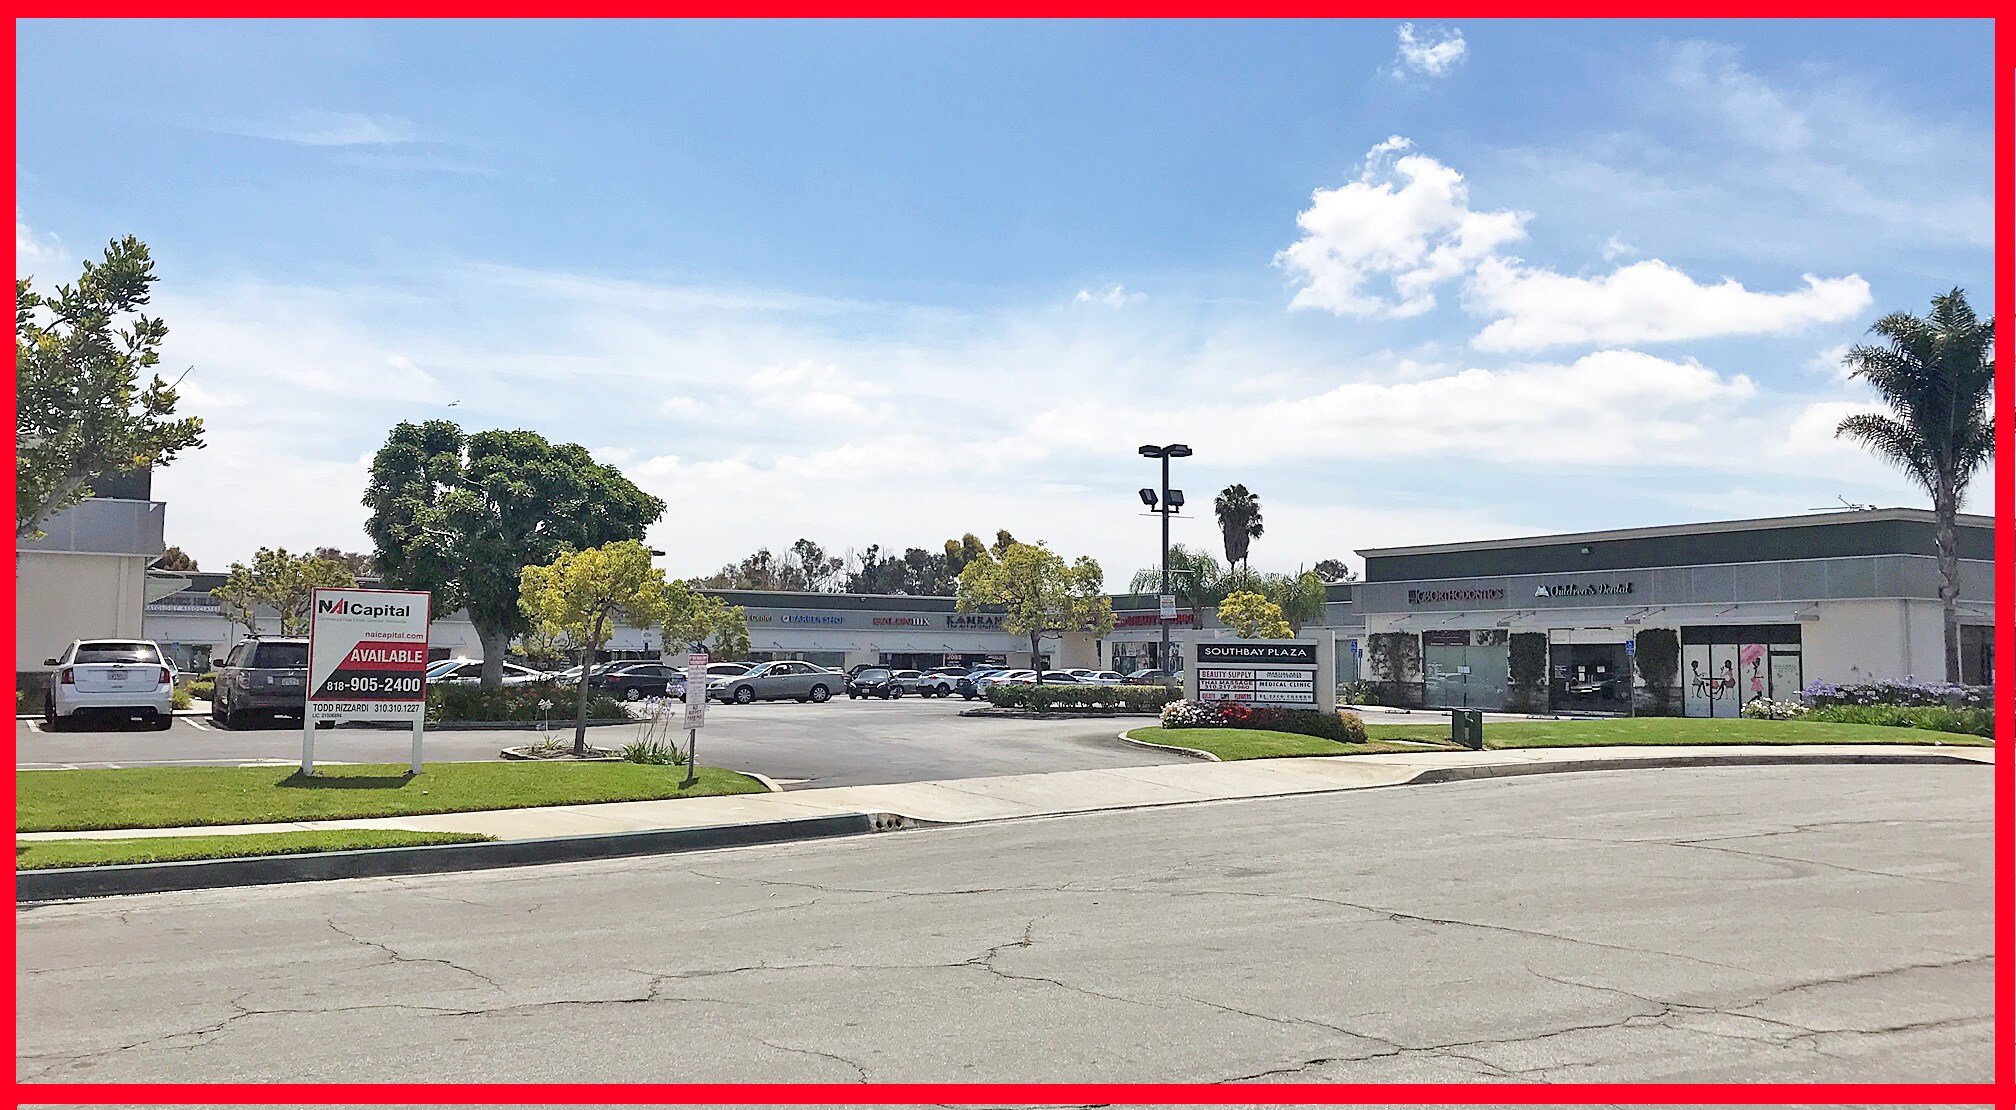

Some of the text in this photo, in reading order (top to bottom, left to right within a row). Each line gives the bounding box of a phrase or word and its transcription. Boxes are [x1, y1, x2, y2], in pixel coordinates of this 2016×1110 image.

[1551, 583, 1595, 597] Children's
[318, 598, 410, 618] NAI Capital
[365, 631, 424, 640] naicapital.com
[350, 649, 422, 663] AVAILABLE
[1204, 647, 1307, 657] SOUTHBAY PLAZA
[1228, 671, 1252, 679] SUPPLY
[326, 677, 421, 692] 818-905-2400
[313, 704, 420, 713] TODD RIZZARDI 310.310.1227
